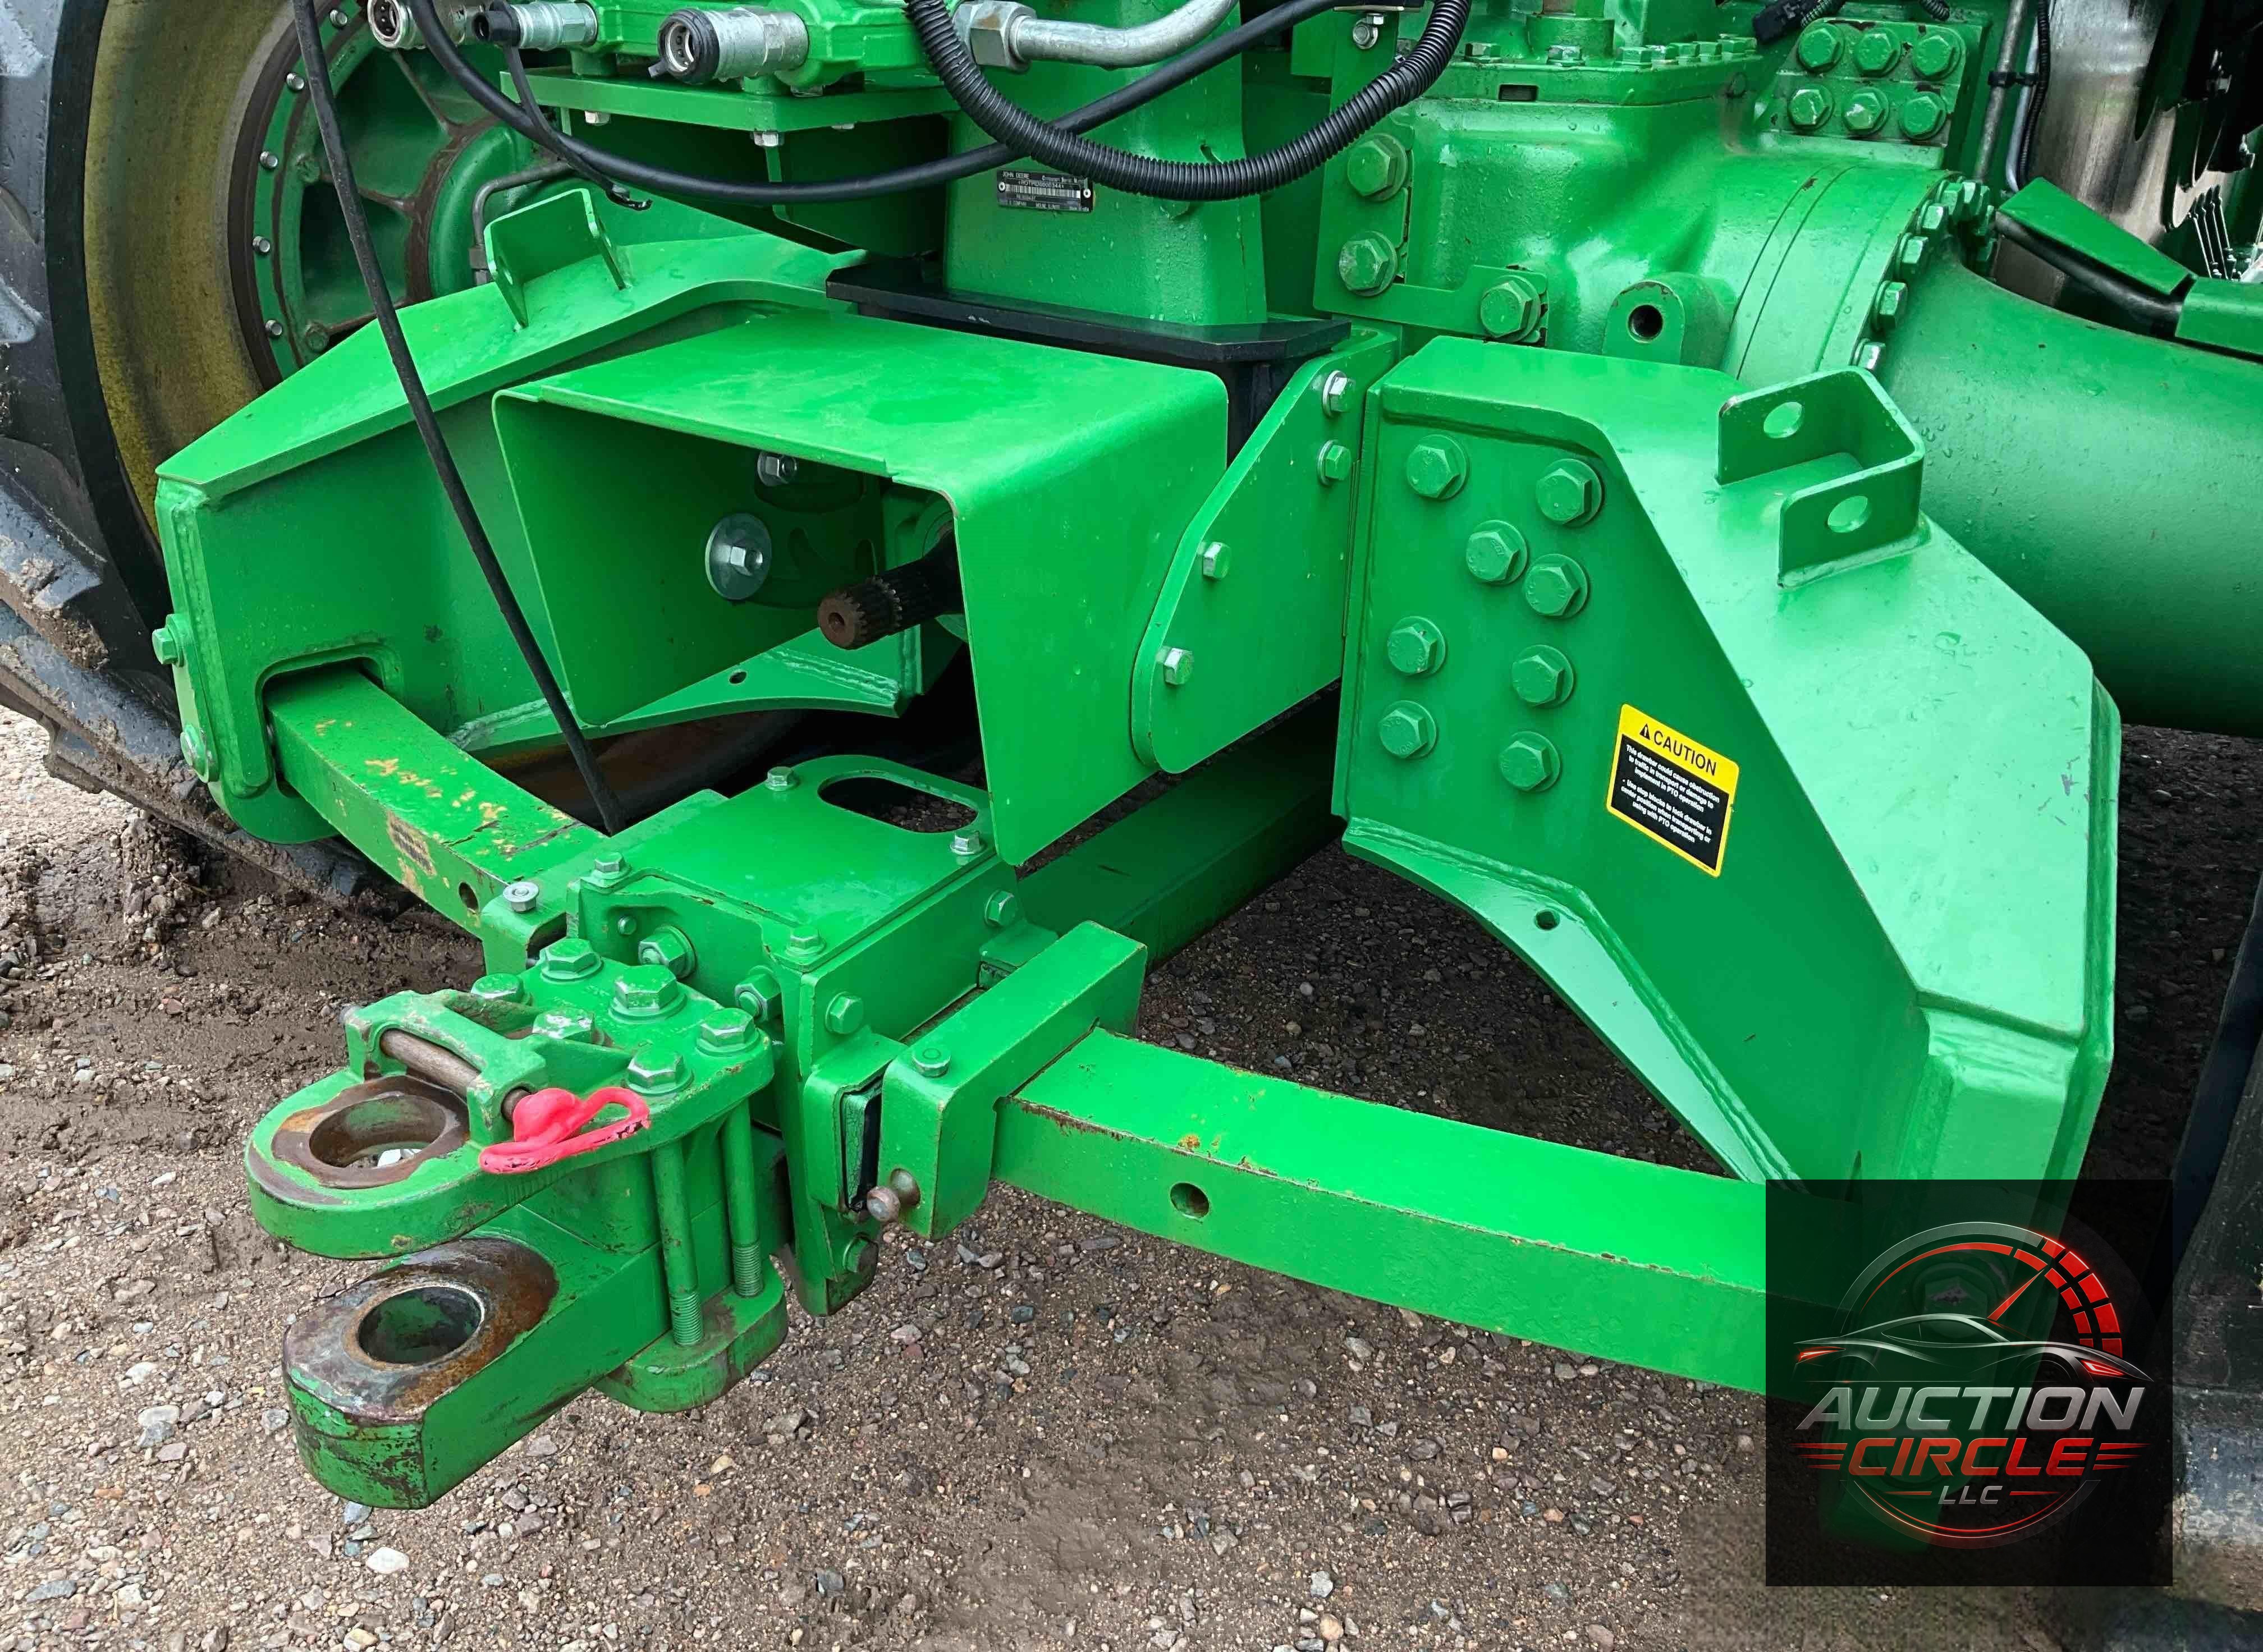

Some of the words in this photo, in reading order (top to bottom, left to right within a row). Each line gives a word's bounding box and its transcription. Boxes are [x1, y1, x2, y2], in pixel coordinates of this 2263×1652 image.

[1627, 744, 1637, 755] This
[1637, 752, 1657, 767] drawbar
[1658, 764, 1673, 776] could
[1673, 773, 1688, 785] cause
[1689, 782, 1720, 803] obstruction
[1654, 730, 1716, 776] CAUTION
[1627, 779, 1637, 790] Use
[1637, 787, 1648, 797] stop
[1672, 806, 1684, 818] lock
[1650, 767, 1655, 775] in
[1655, 770, 1679, 789] transport
[1686, 789, 1707, 805] damage
[1707, 800, 1714, 809] to
[1661, 782, 1666, 790] in
[1667, 786, 1679, 797] PTO
[1679, 795, 1704, 813] operation
[1632, 801, 1647, 815] using
[1647, 810, 1657, 820] with
[1659, 816, 1670, 827] PTO
[1670, 824, 1695, 843] operation
[1637, 795, 1657, 811] position
[1657, 807, 1671, 820] when
[1672, 815, 1704, 841] transporting
